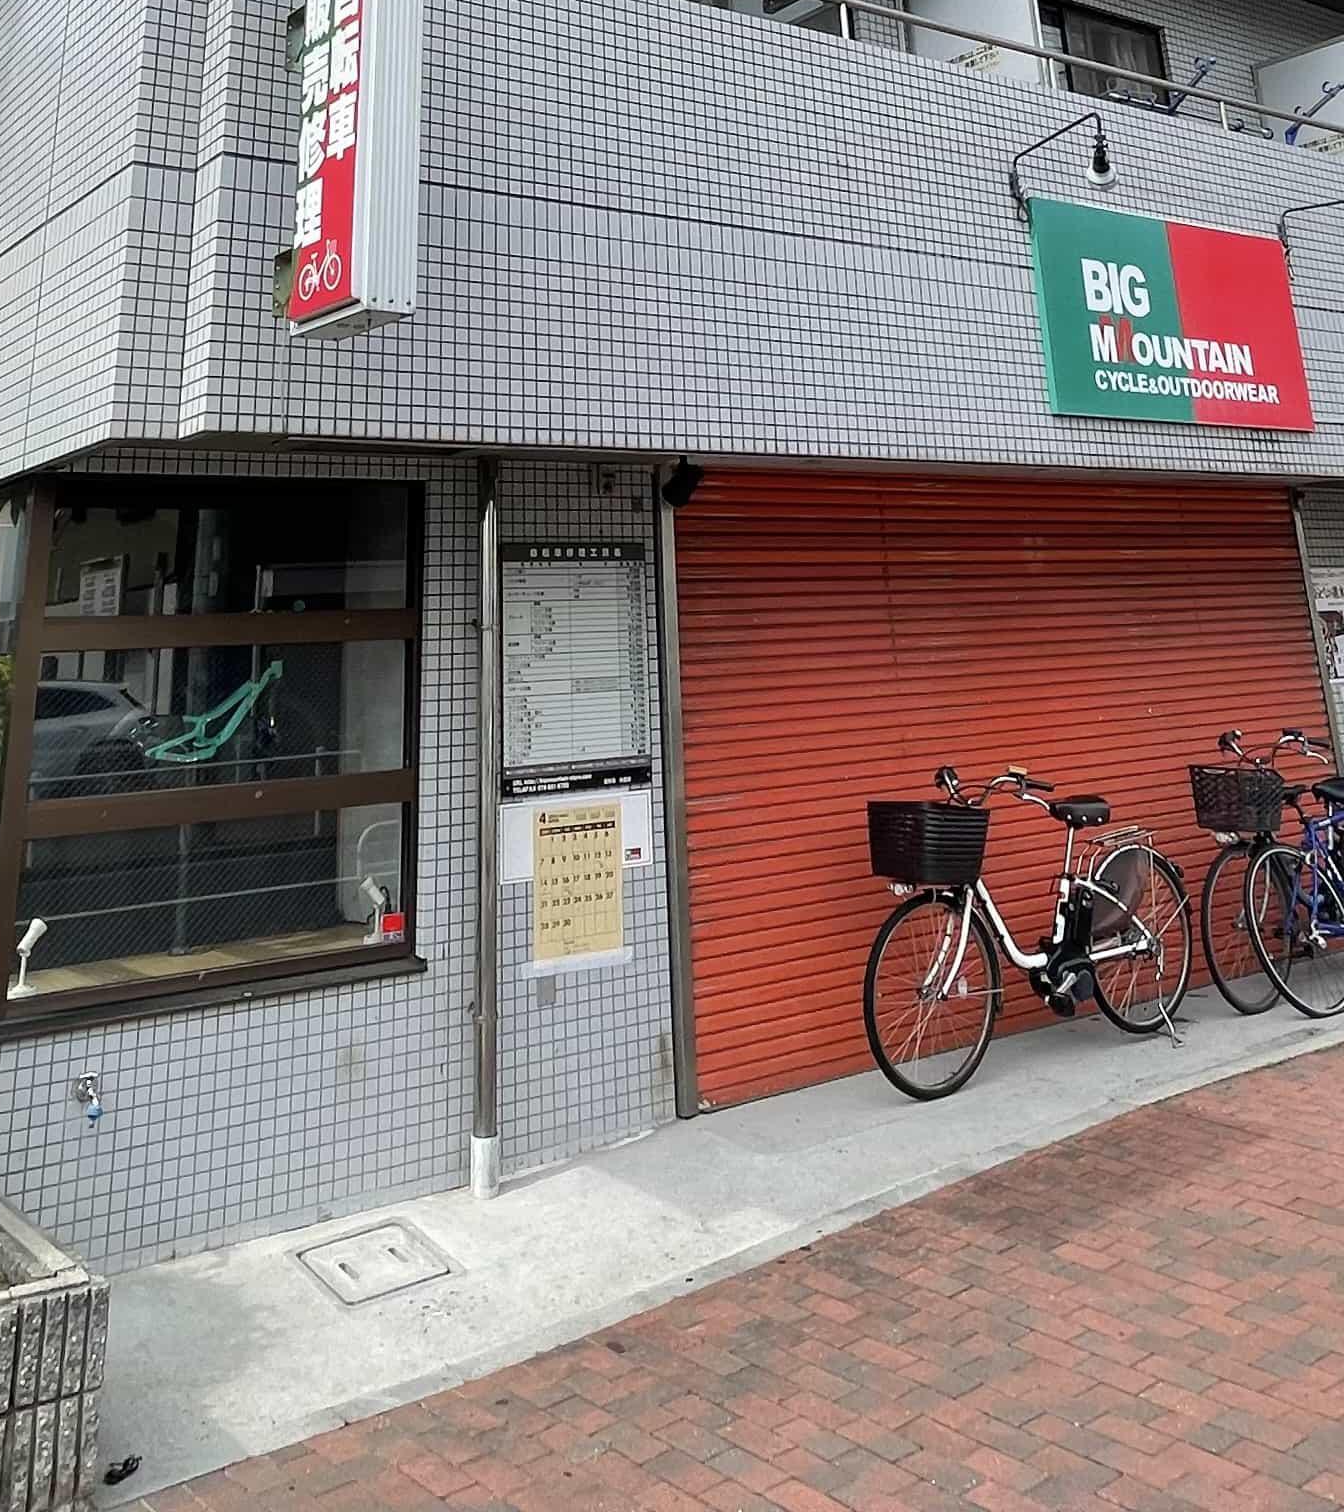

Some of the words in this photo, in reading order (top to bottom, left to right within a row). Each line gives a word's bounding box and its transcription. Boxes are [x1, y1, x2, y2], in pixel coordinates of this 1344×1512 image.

[1080, 258, 1150, 317] BIG
[1089, 322, 1254, 376] MOUNTAIN
[1095, 369, 1280, 404] CYCLE&OUTDOORWEAR
[539, 813, 546, 824] 4
